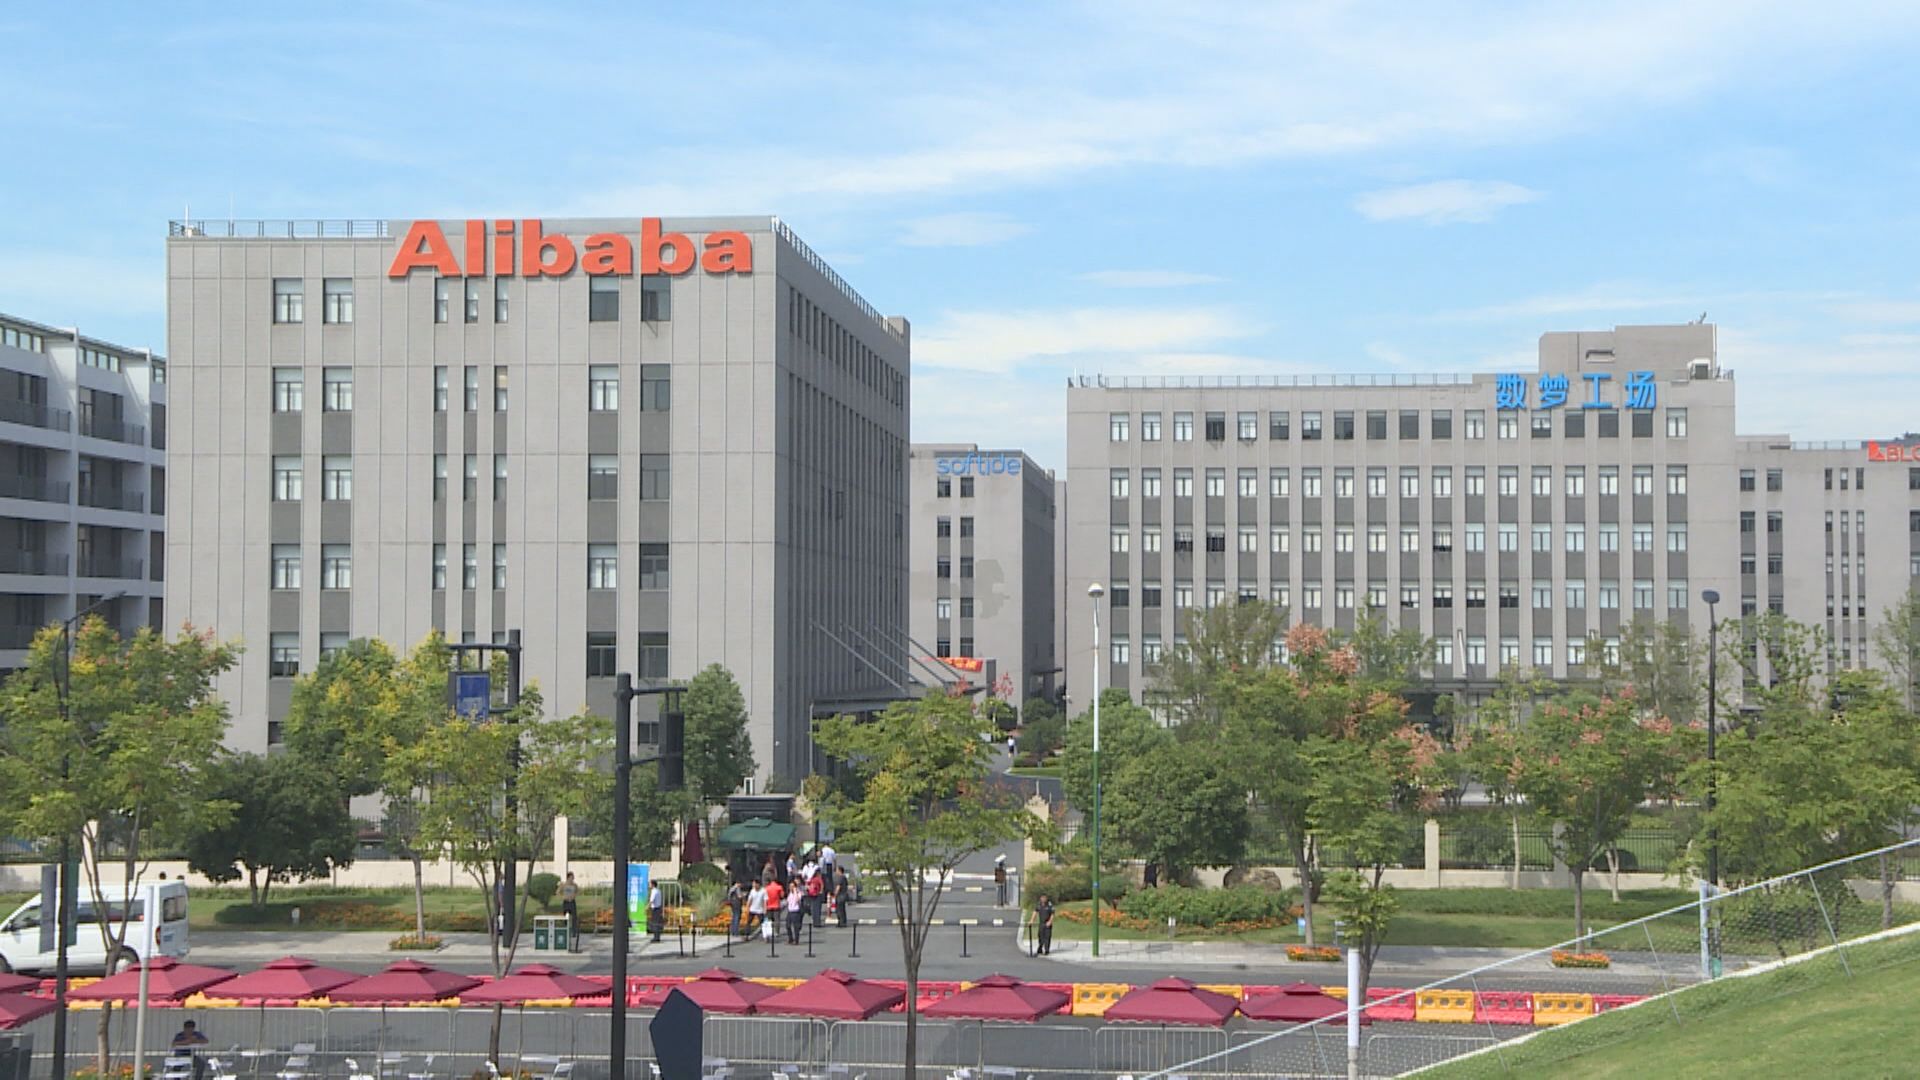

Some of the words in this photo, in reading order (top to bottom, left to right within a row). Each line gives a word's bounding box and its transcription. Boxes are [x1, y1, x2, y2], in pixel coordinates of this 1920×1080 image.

[388, 217, 753, 277] Alibaba
[1496, 371, 1657, 410] 数梦工场
